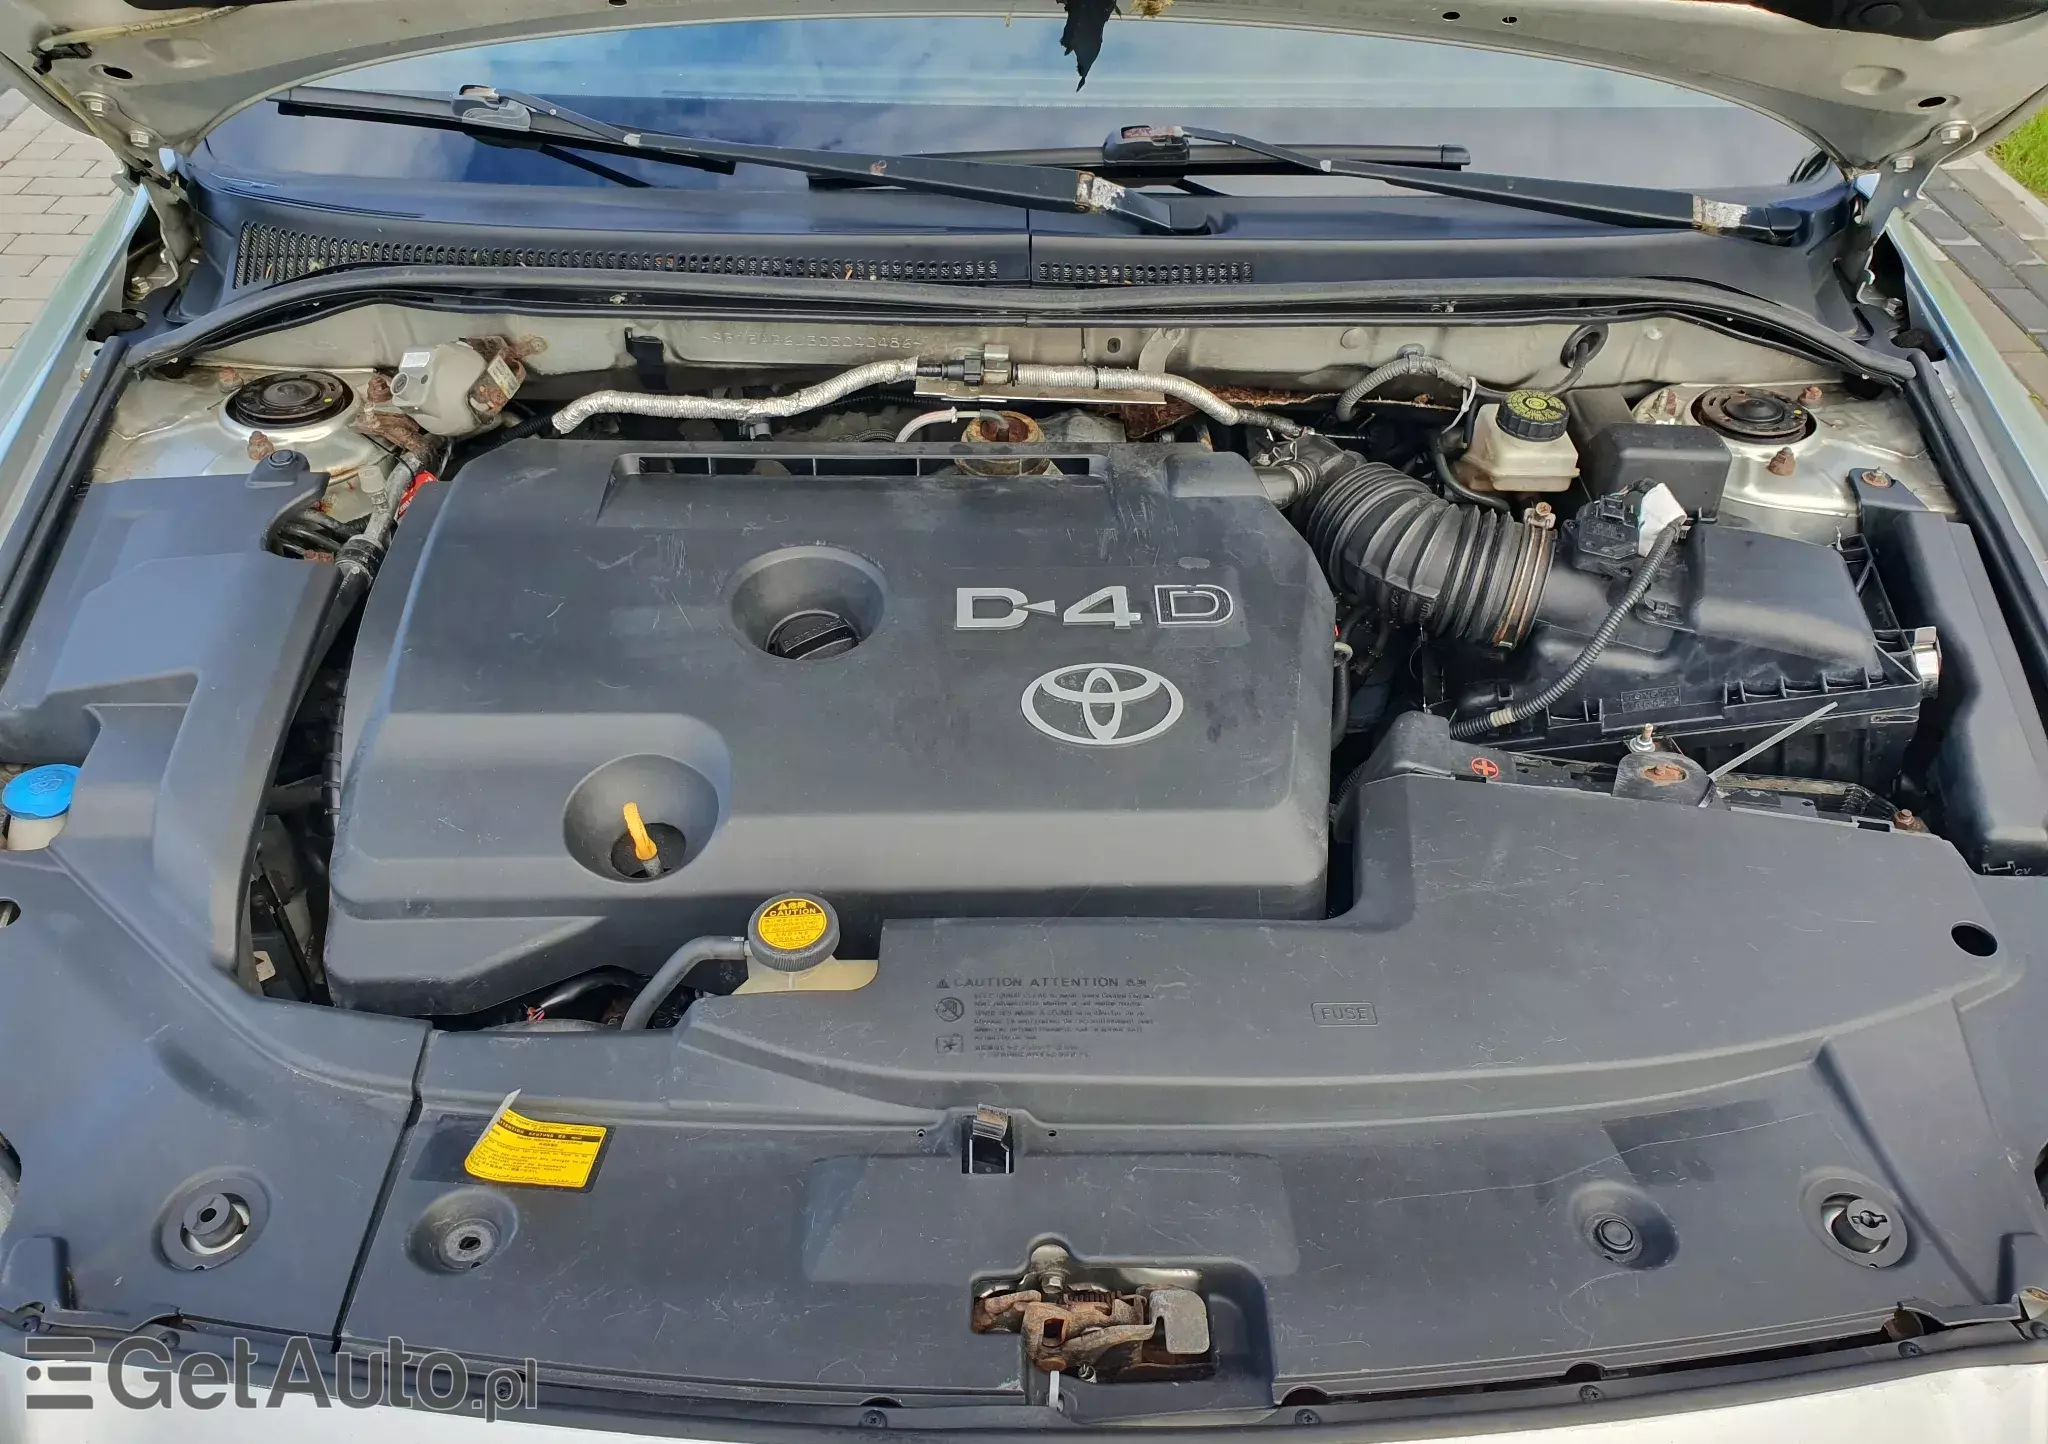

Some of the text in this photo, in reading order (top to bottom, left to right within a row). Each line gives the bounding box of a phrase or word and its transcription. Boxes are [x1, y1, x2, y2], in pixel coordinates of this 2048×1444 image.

[769, 907, 816, 917] CAUTION
[954, 977, 1022, 988] CAUTION
[1030, 977, 1119, 988] ATTENTION
[1321, 1007, 1368, 1021] FUSE
